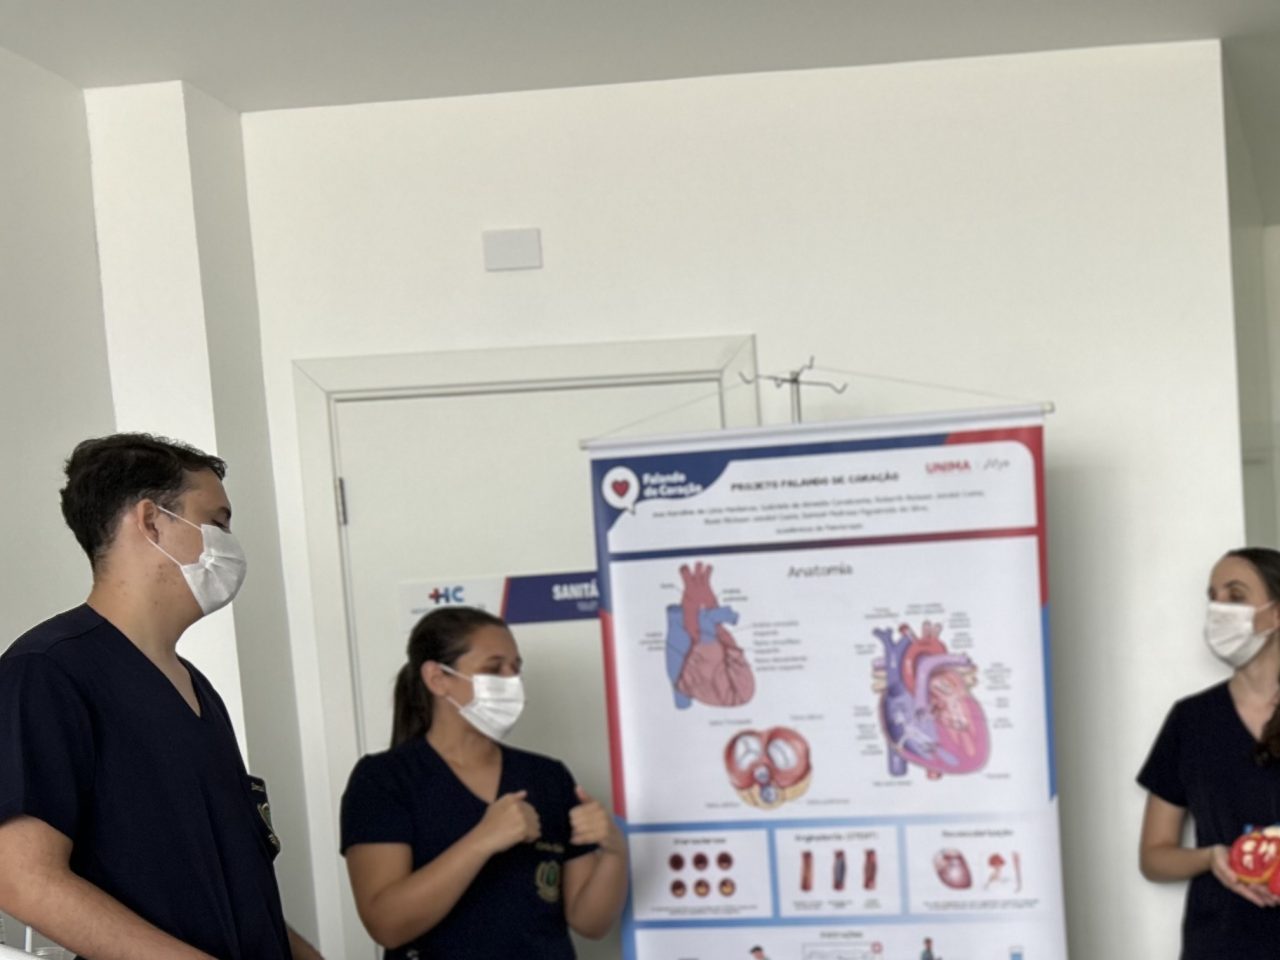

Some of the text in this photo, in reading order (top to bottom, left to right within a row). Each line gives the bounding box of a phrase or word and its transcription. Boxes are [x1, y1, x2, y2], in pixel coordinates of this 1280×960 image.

[642, 471, 686, 485] Falando
[730, 480, 778, 491] PROJETO
[781, 477, 828, 488] FALANDO
[832, 475, 845, 484] DE
[660, 482, 702, 498] Coração
[788, 561, 854, 579] Anatomia
[553, 579, 599, 600] SANITÁ
